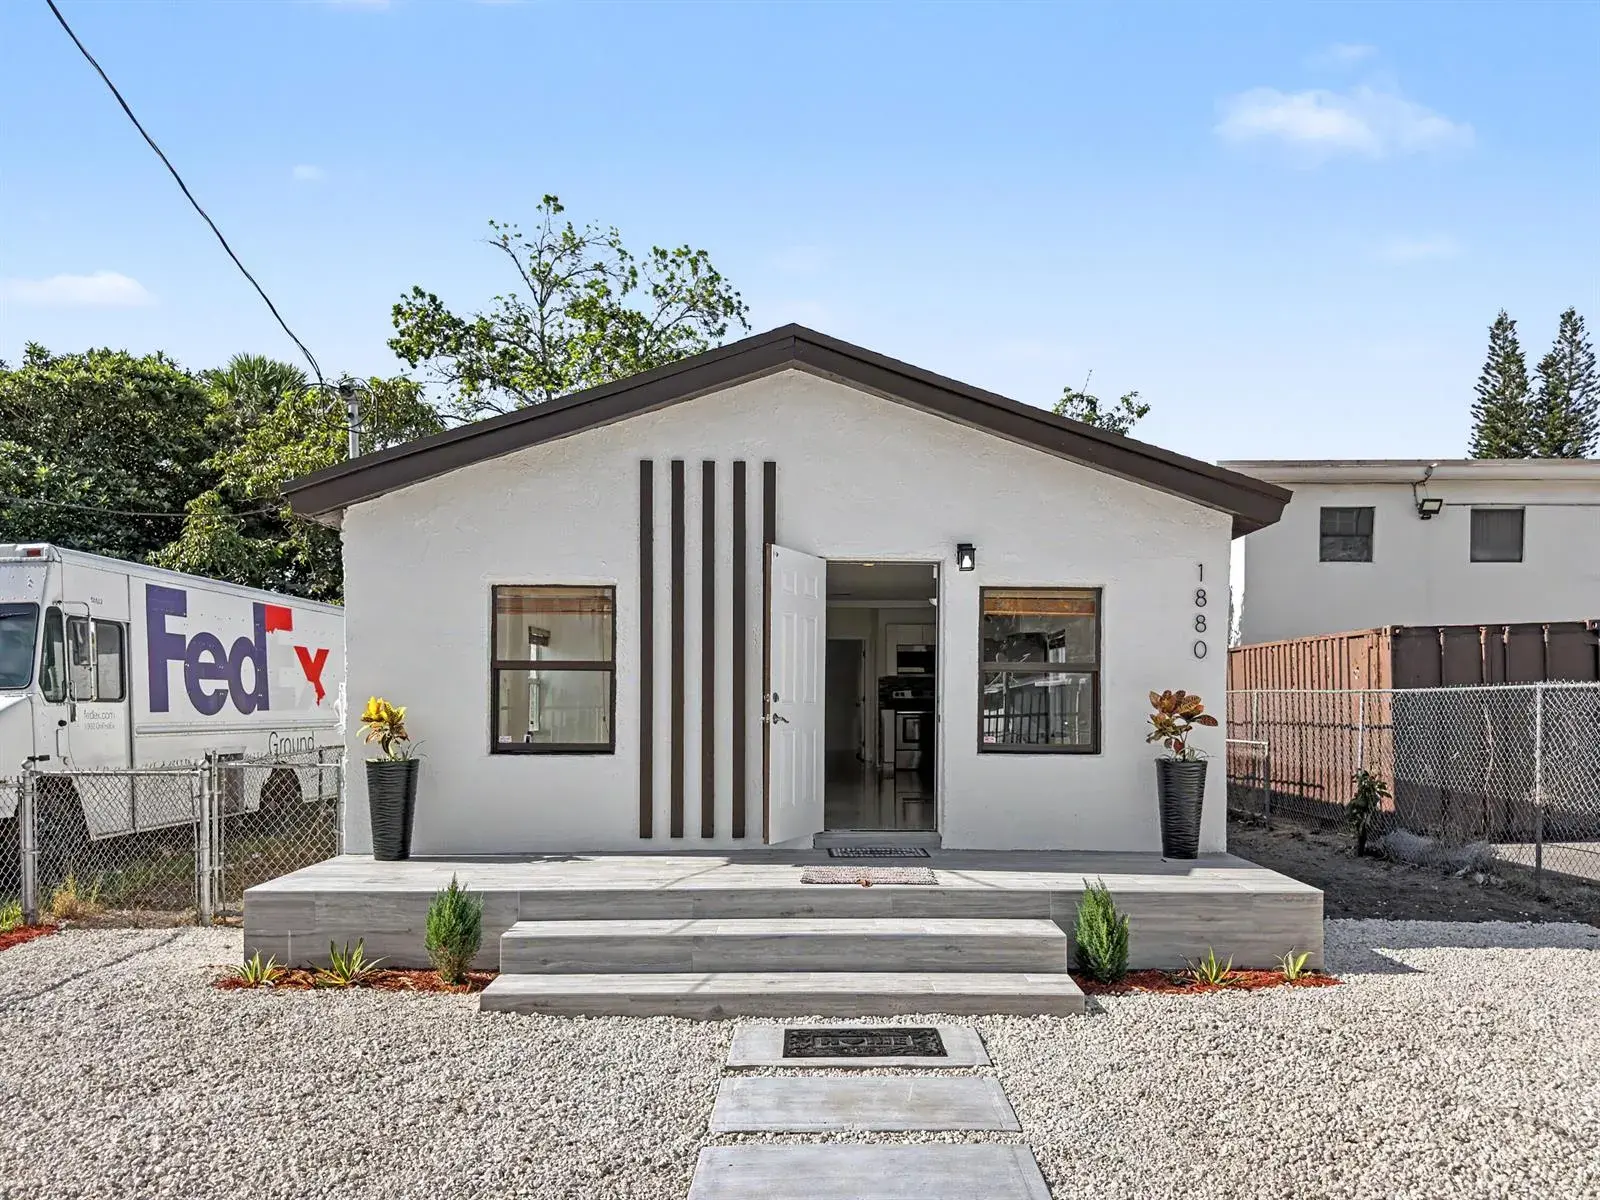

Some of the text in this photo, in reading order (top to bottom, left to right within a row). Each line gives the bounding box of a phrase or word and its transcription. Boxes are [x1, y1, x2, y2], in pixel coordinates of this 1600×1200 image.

[145, 583, 331, 716] Fedx
[1193, 563, 1207, 659] 1880
[268, 730, 315, 755] Ground
